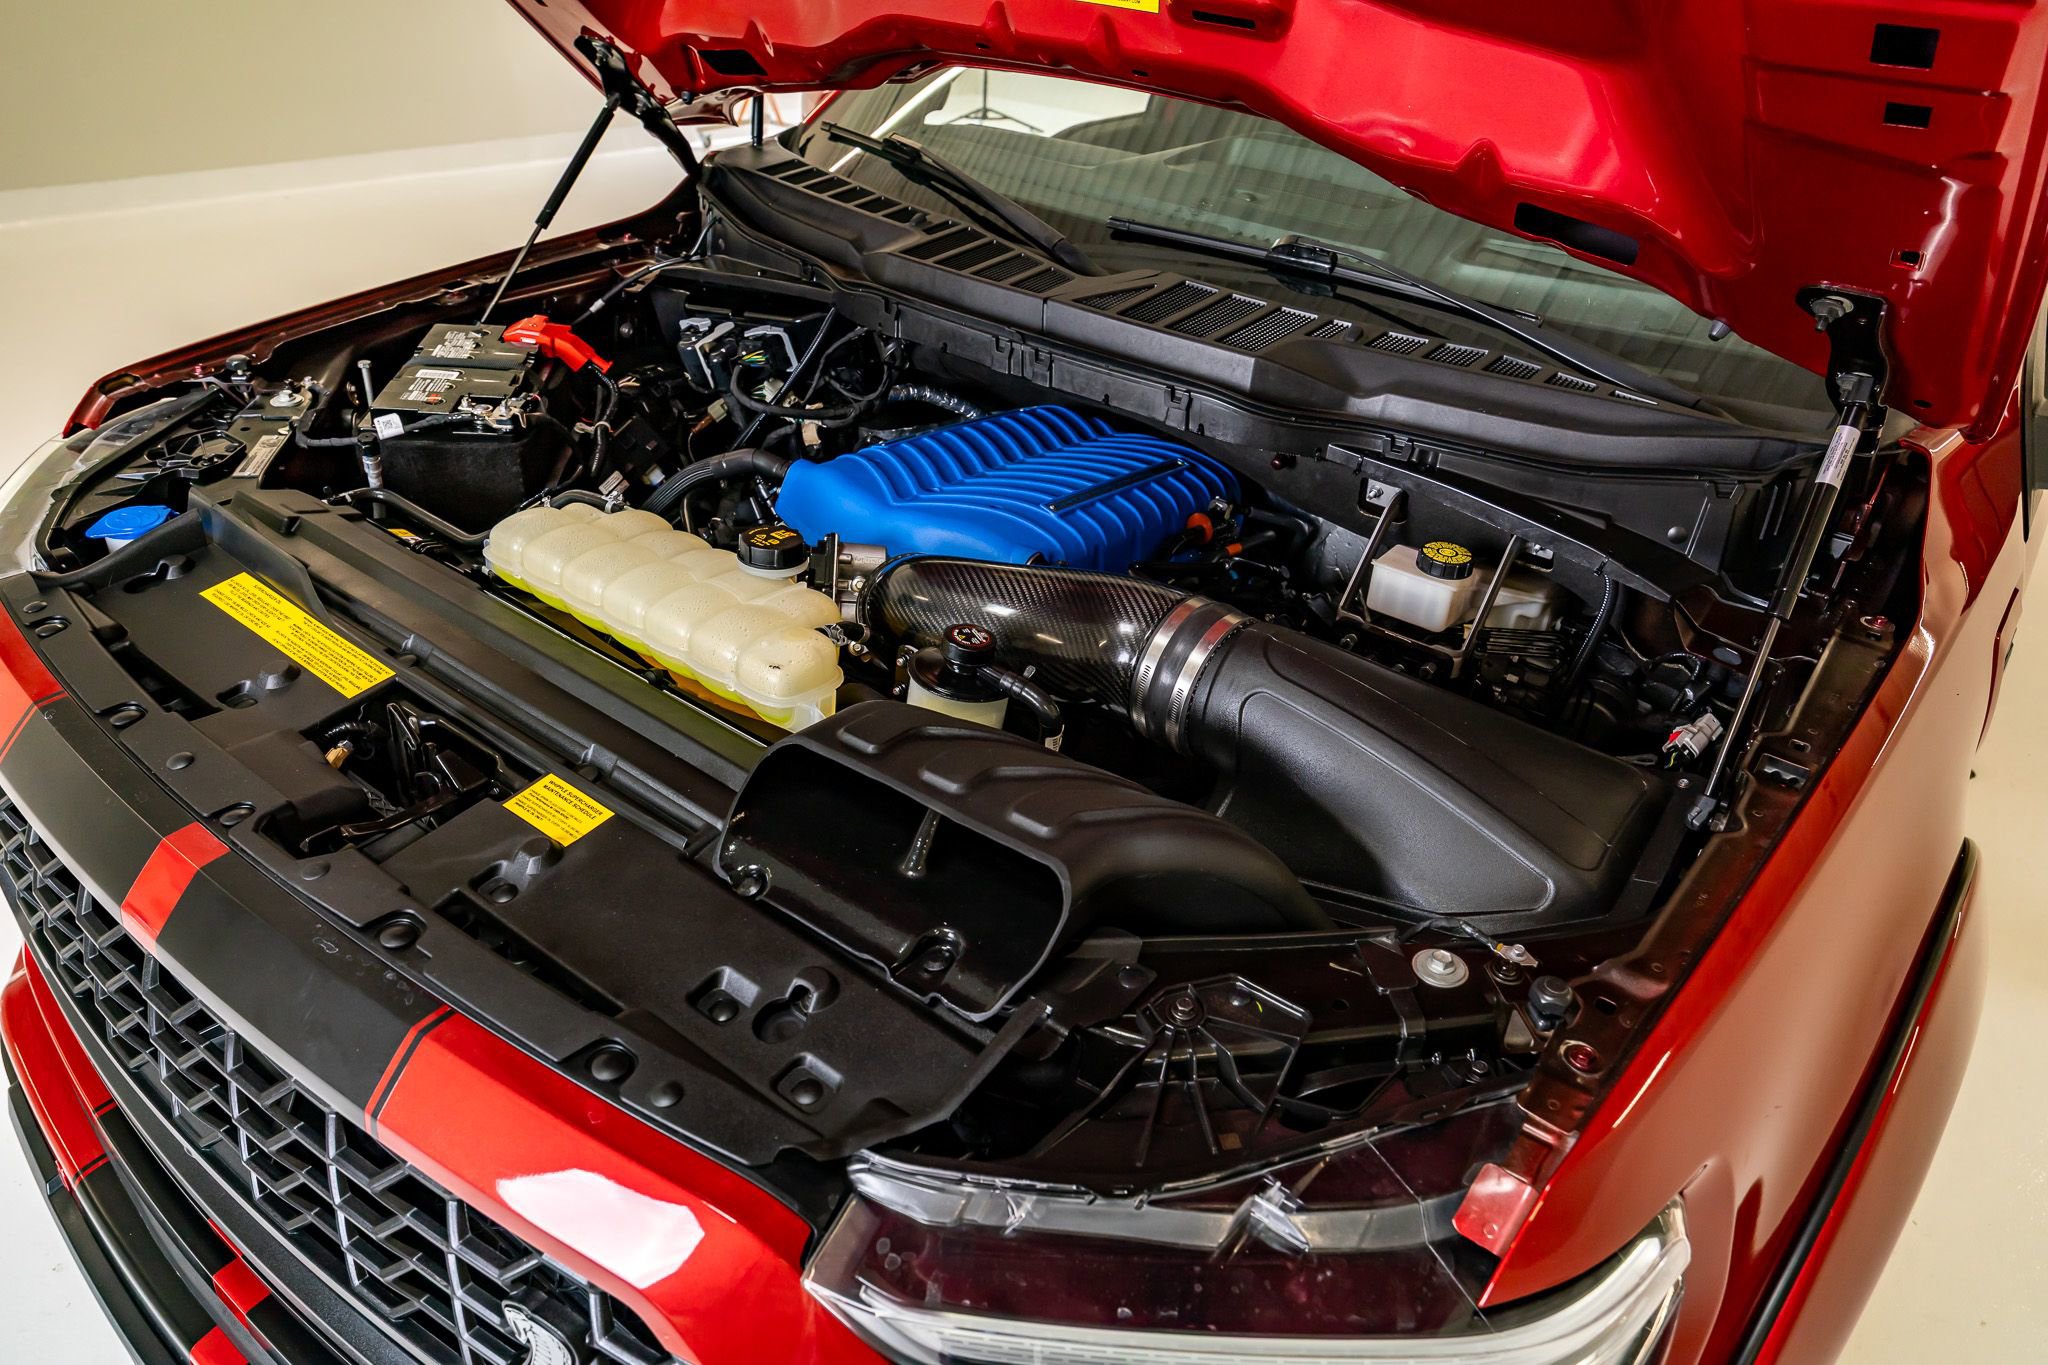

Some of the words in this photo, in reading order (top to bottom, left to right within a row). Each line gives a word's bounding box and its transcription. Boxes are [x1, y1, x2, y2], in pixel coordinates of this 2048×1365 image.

[543, 784, 573, 805] MAINTENANCE
[572, 803, 597, 820] SCHEDULE
[548, 780, 568, 794] WHIPPLE
[568, 791, 604, 816] SUPERCHARGER
